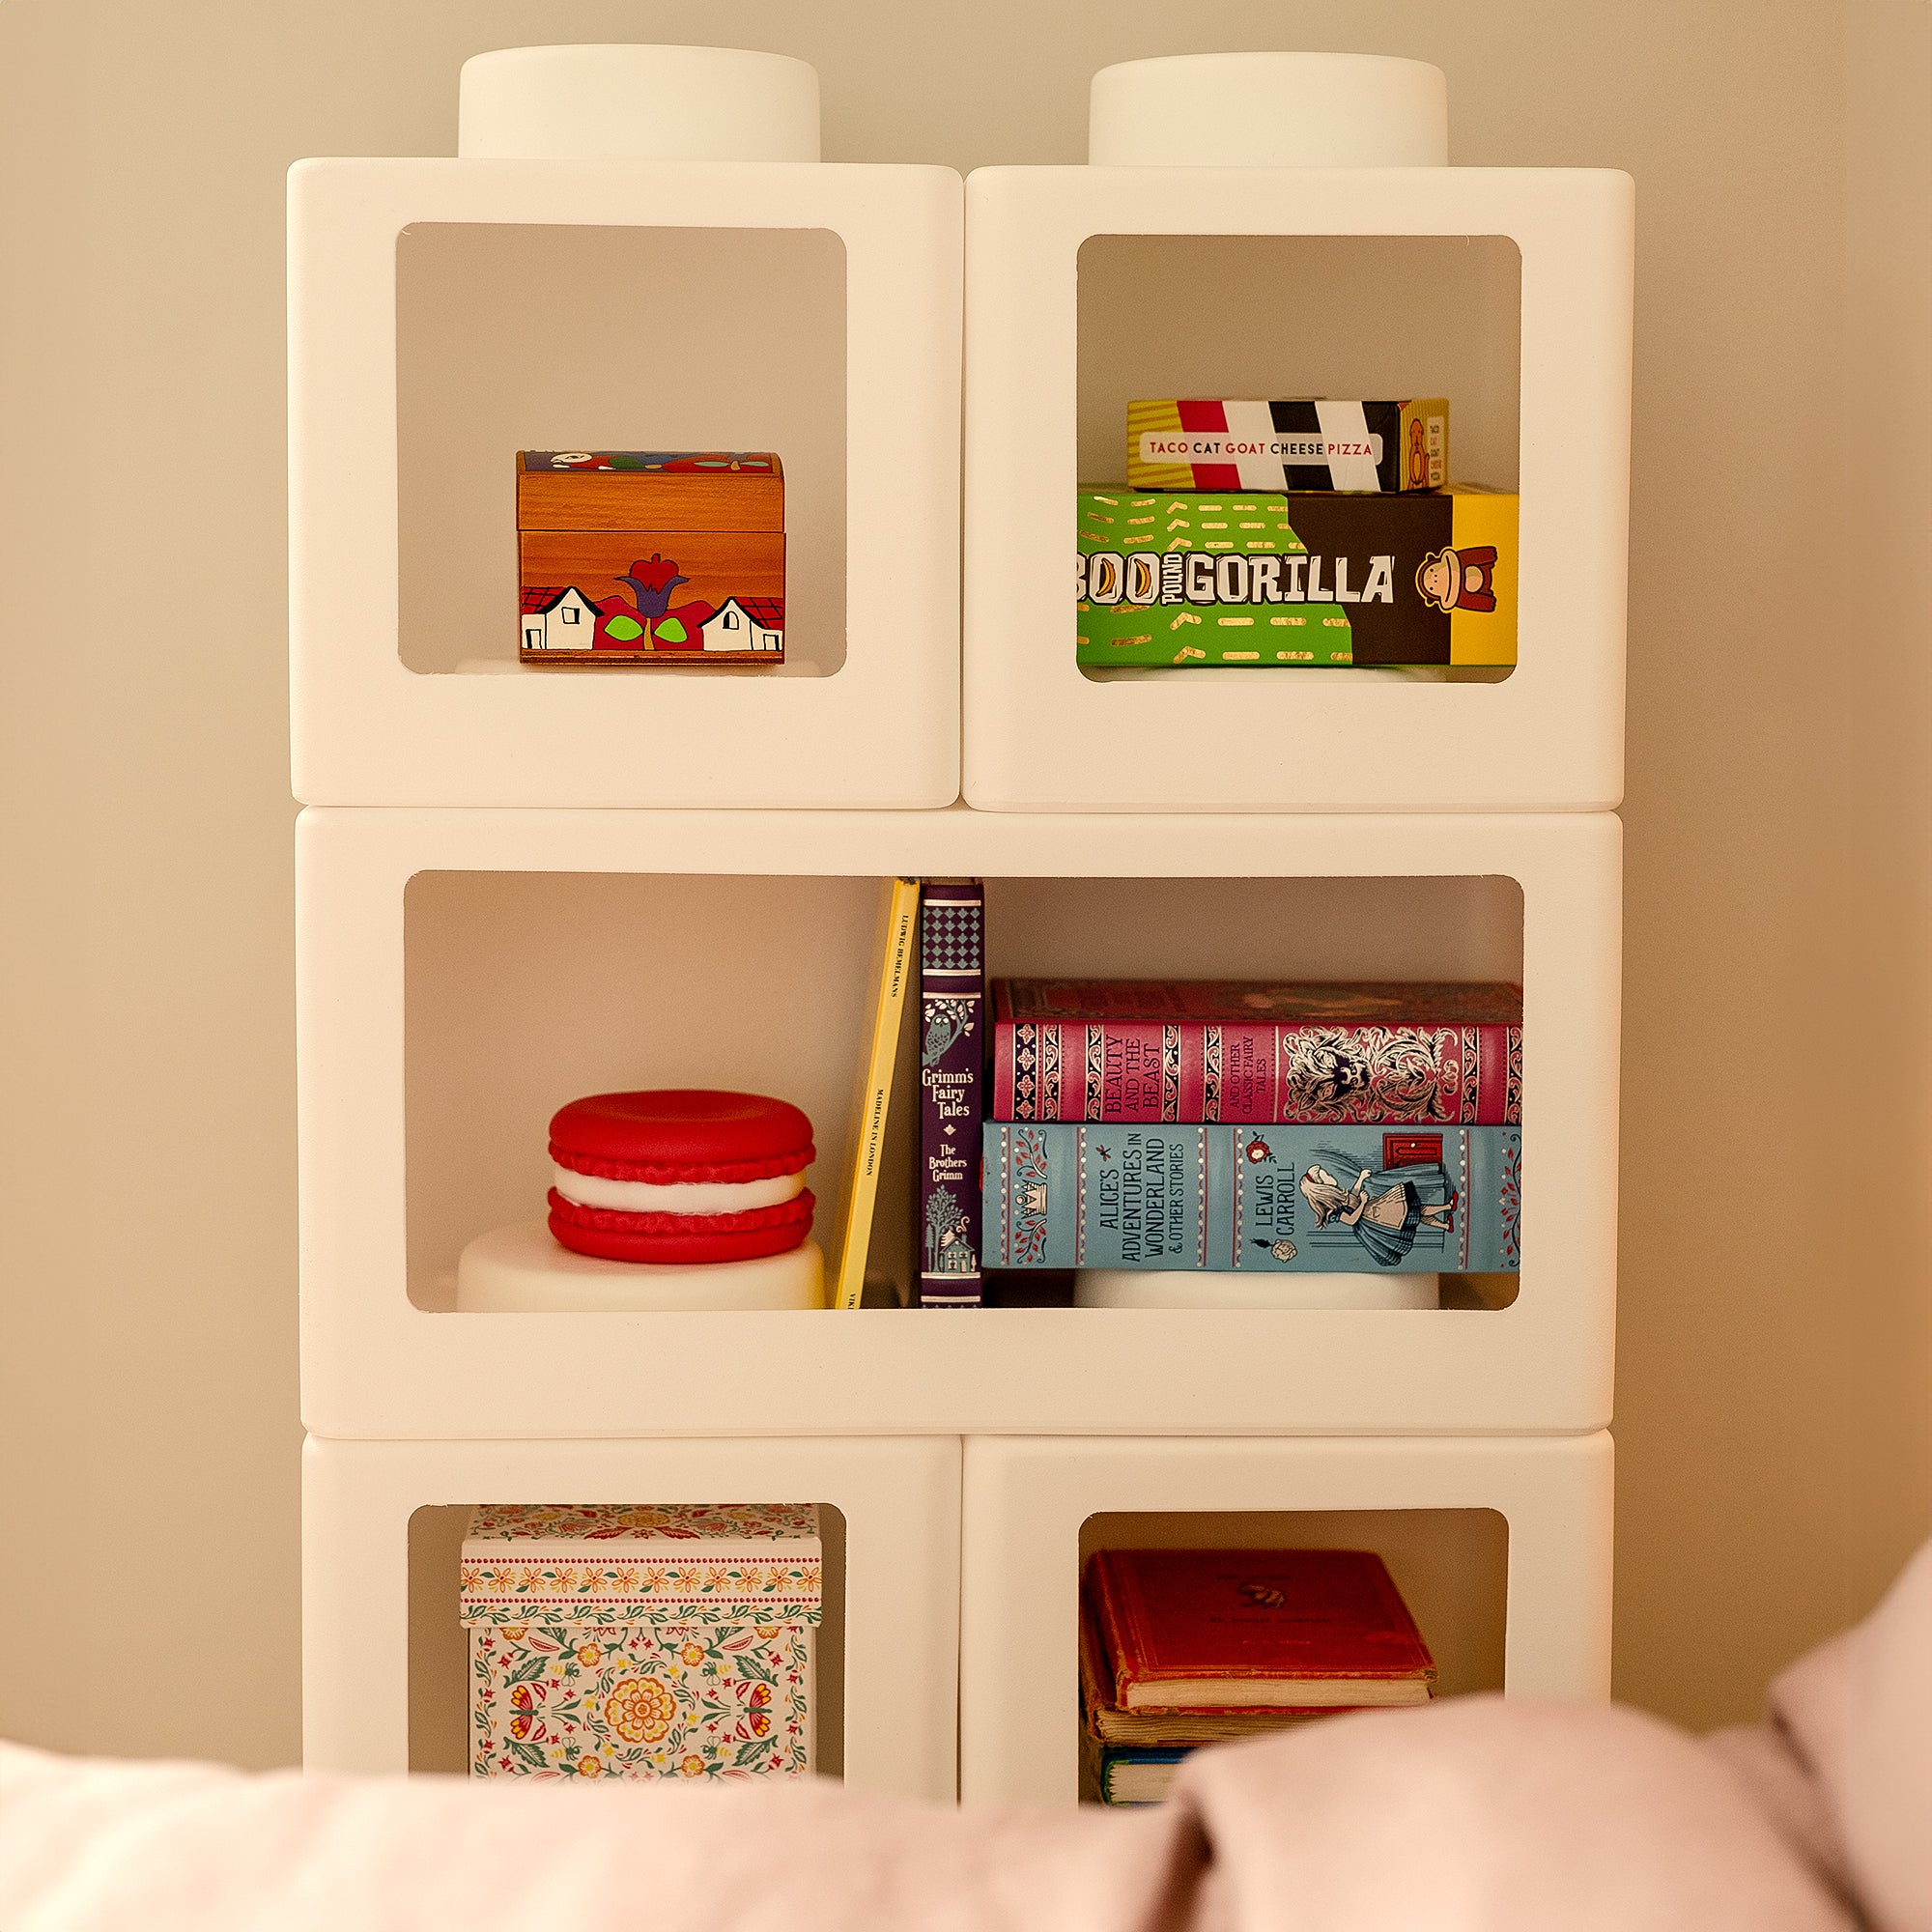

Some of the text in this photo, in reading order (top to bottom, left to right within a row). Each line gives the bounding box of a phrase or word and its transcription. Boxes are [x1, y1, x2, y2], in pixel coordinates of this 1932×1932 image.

[1150, 441, 1372, 456] TACO CAT GOAT CHEESE PIZZA
[1161, 554, 1183, 604] POUND
[1185, 554, 1395, 603] GORILLA
[898, 915, 909, 947] LUDWIG
[922, 1067, 974, 1087] Grimm's
[932, 1084, 965, 1103] Fairy
[1105, 1035, 1122, 1114] BEAUTY
[1124, 1037, 1140, 1112] AND THE
[1143, 1042, 1159, 1109] BEAST
[1230, 1042, 1240, 1109] AND OTHER
[1242, 1036, 1254, 1115] CLASSIC FAIRY
[1256, 1058, 1266, 1094] TALES
[867, 1089, 884, 1176] MADELINE IN LONDON
[937, 1101, 970, 1120] Tales
[929, 1156, 968, 1170] Brothers
[932, 1169, 963, 1182] Grimm
[940, 1144, 956, 1157] The
[1099, 1168, 1120, 1230] ALICE'S
[1122, 1132, 1142, 1263] ADVENTURES IN
[1145, 1137, 1164, 1258] WONDERLAND
[1169, 1143, 1184, 1254] & OTHER STORIES
[1256, 1174, 1273, 1227] LEWIS
[1276, 1161, 1295, 1236] CARROLL
